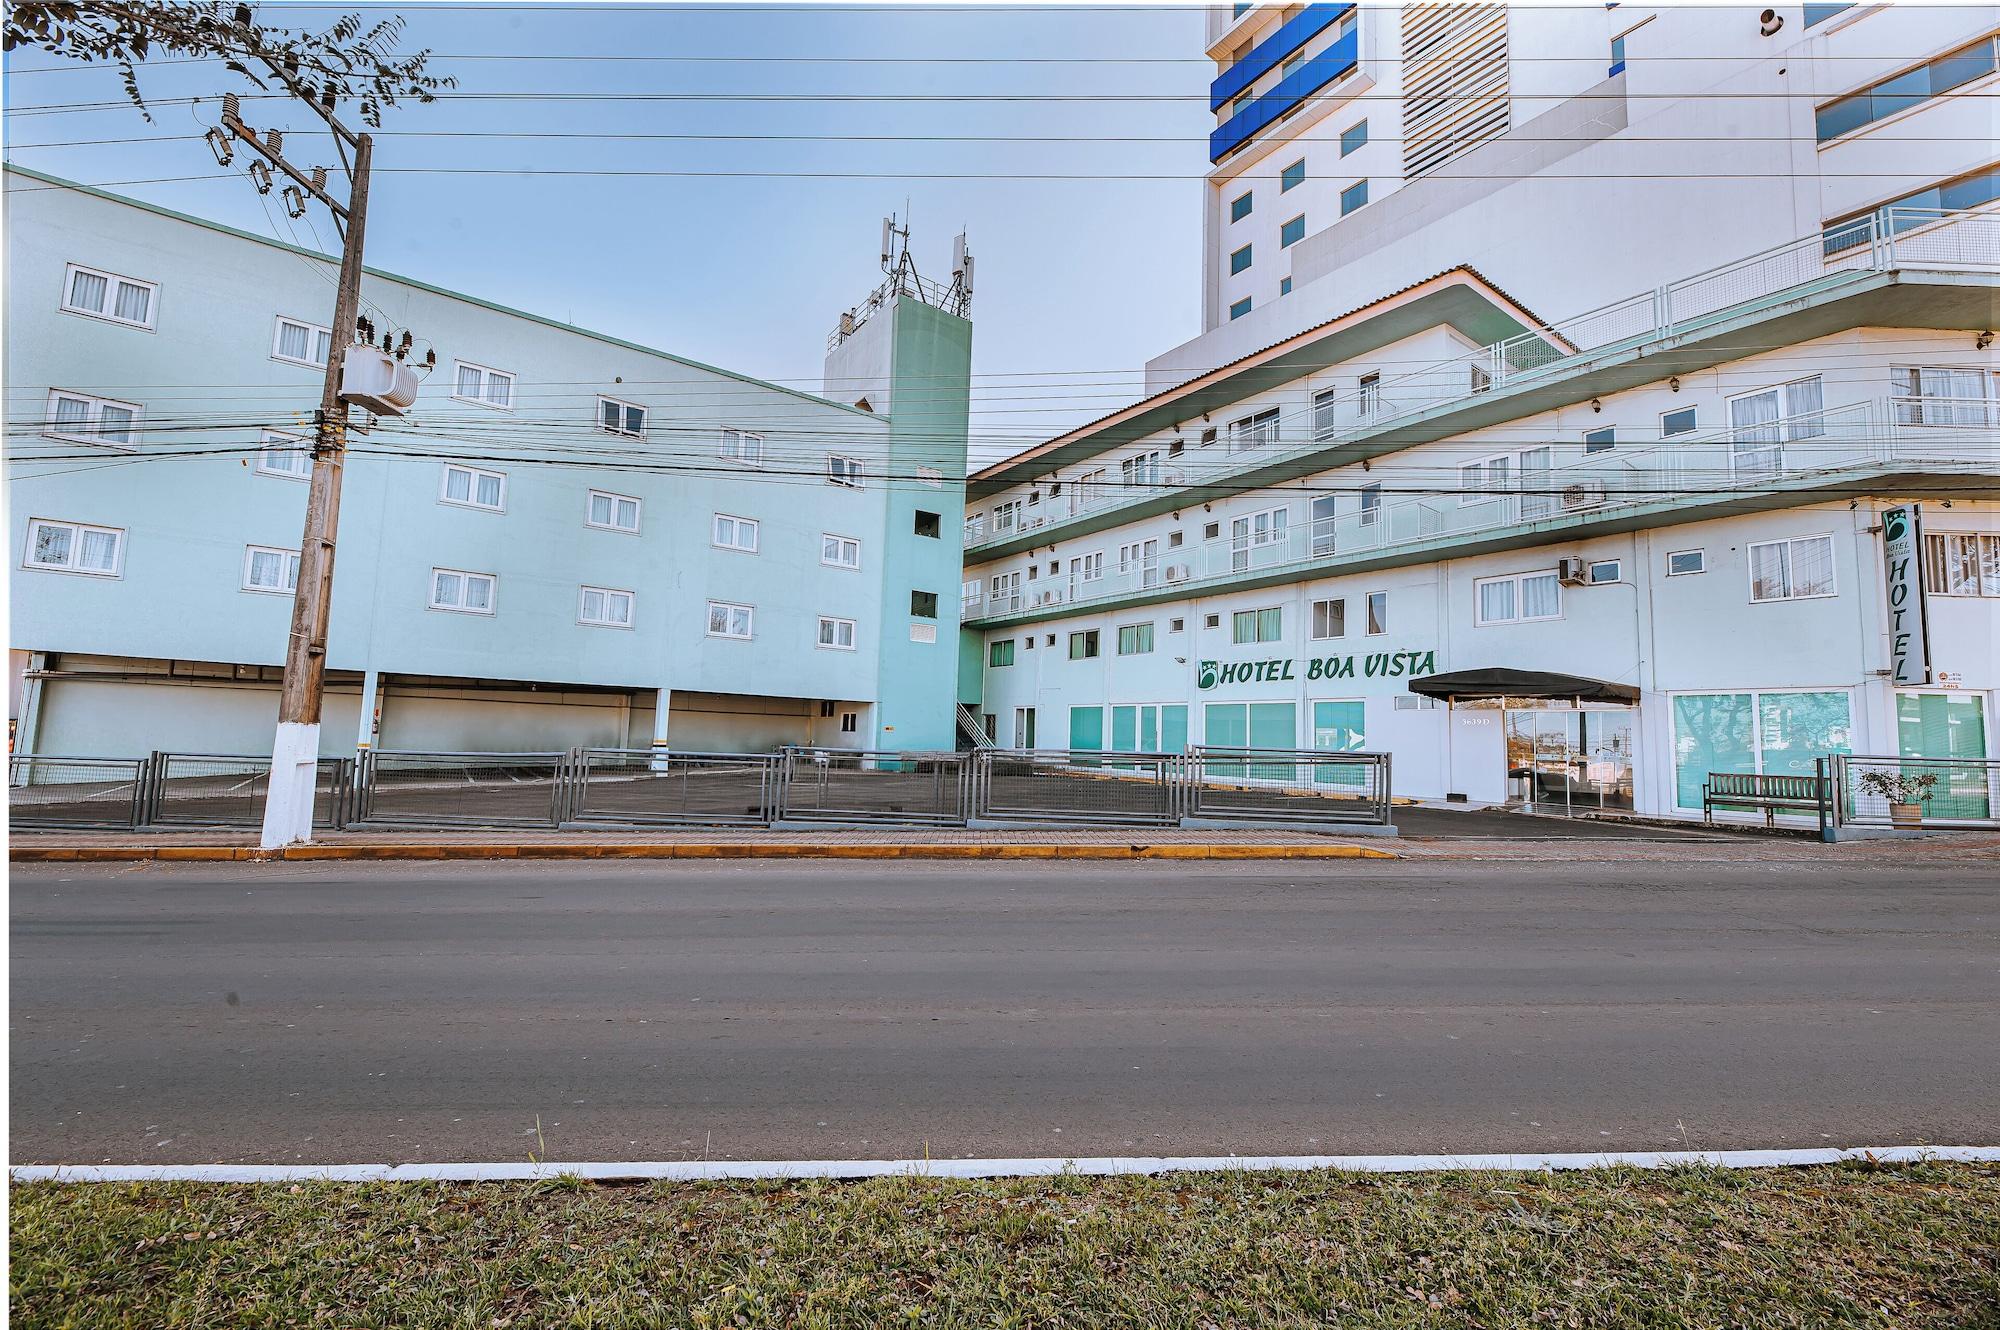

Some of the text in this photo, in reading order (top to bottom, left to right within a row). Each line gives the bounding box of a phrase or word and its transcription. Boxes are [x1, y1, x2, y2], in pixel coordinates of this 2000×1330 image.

[1889, 557, 1911, 681] HOTEL
[1220, 650, 1436, 683] HOTEL BOA VISTA
